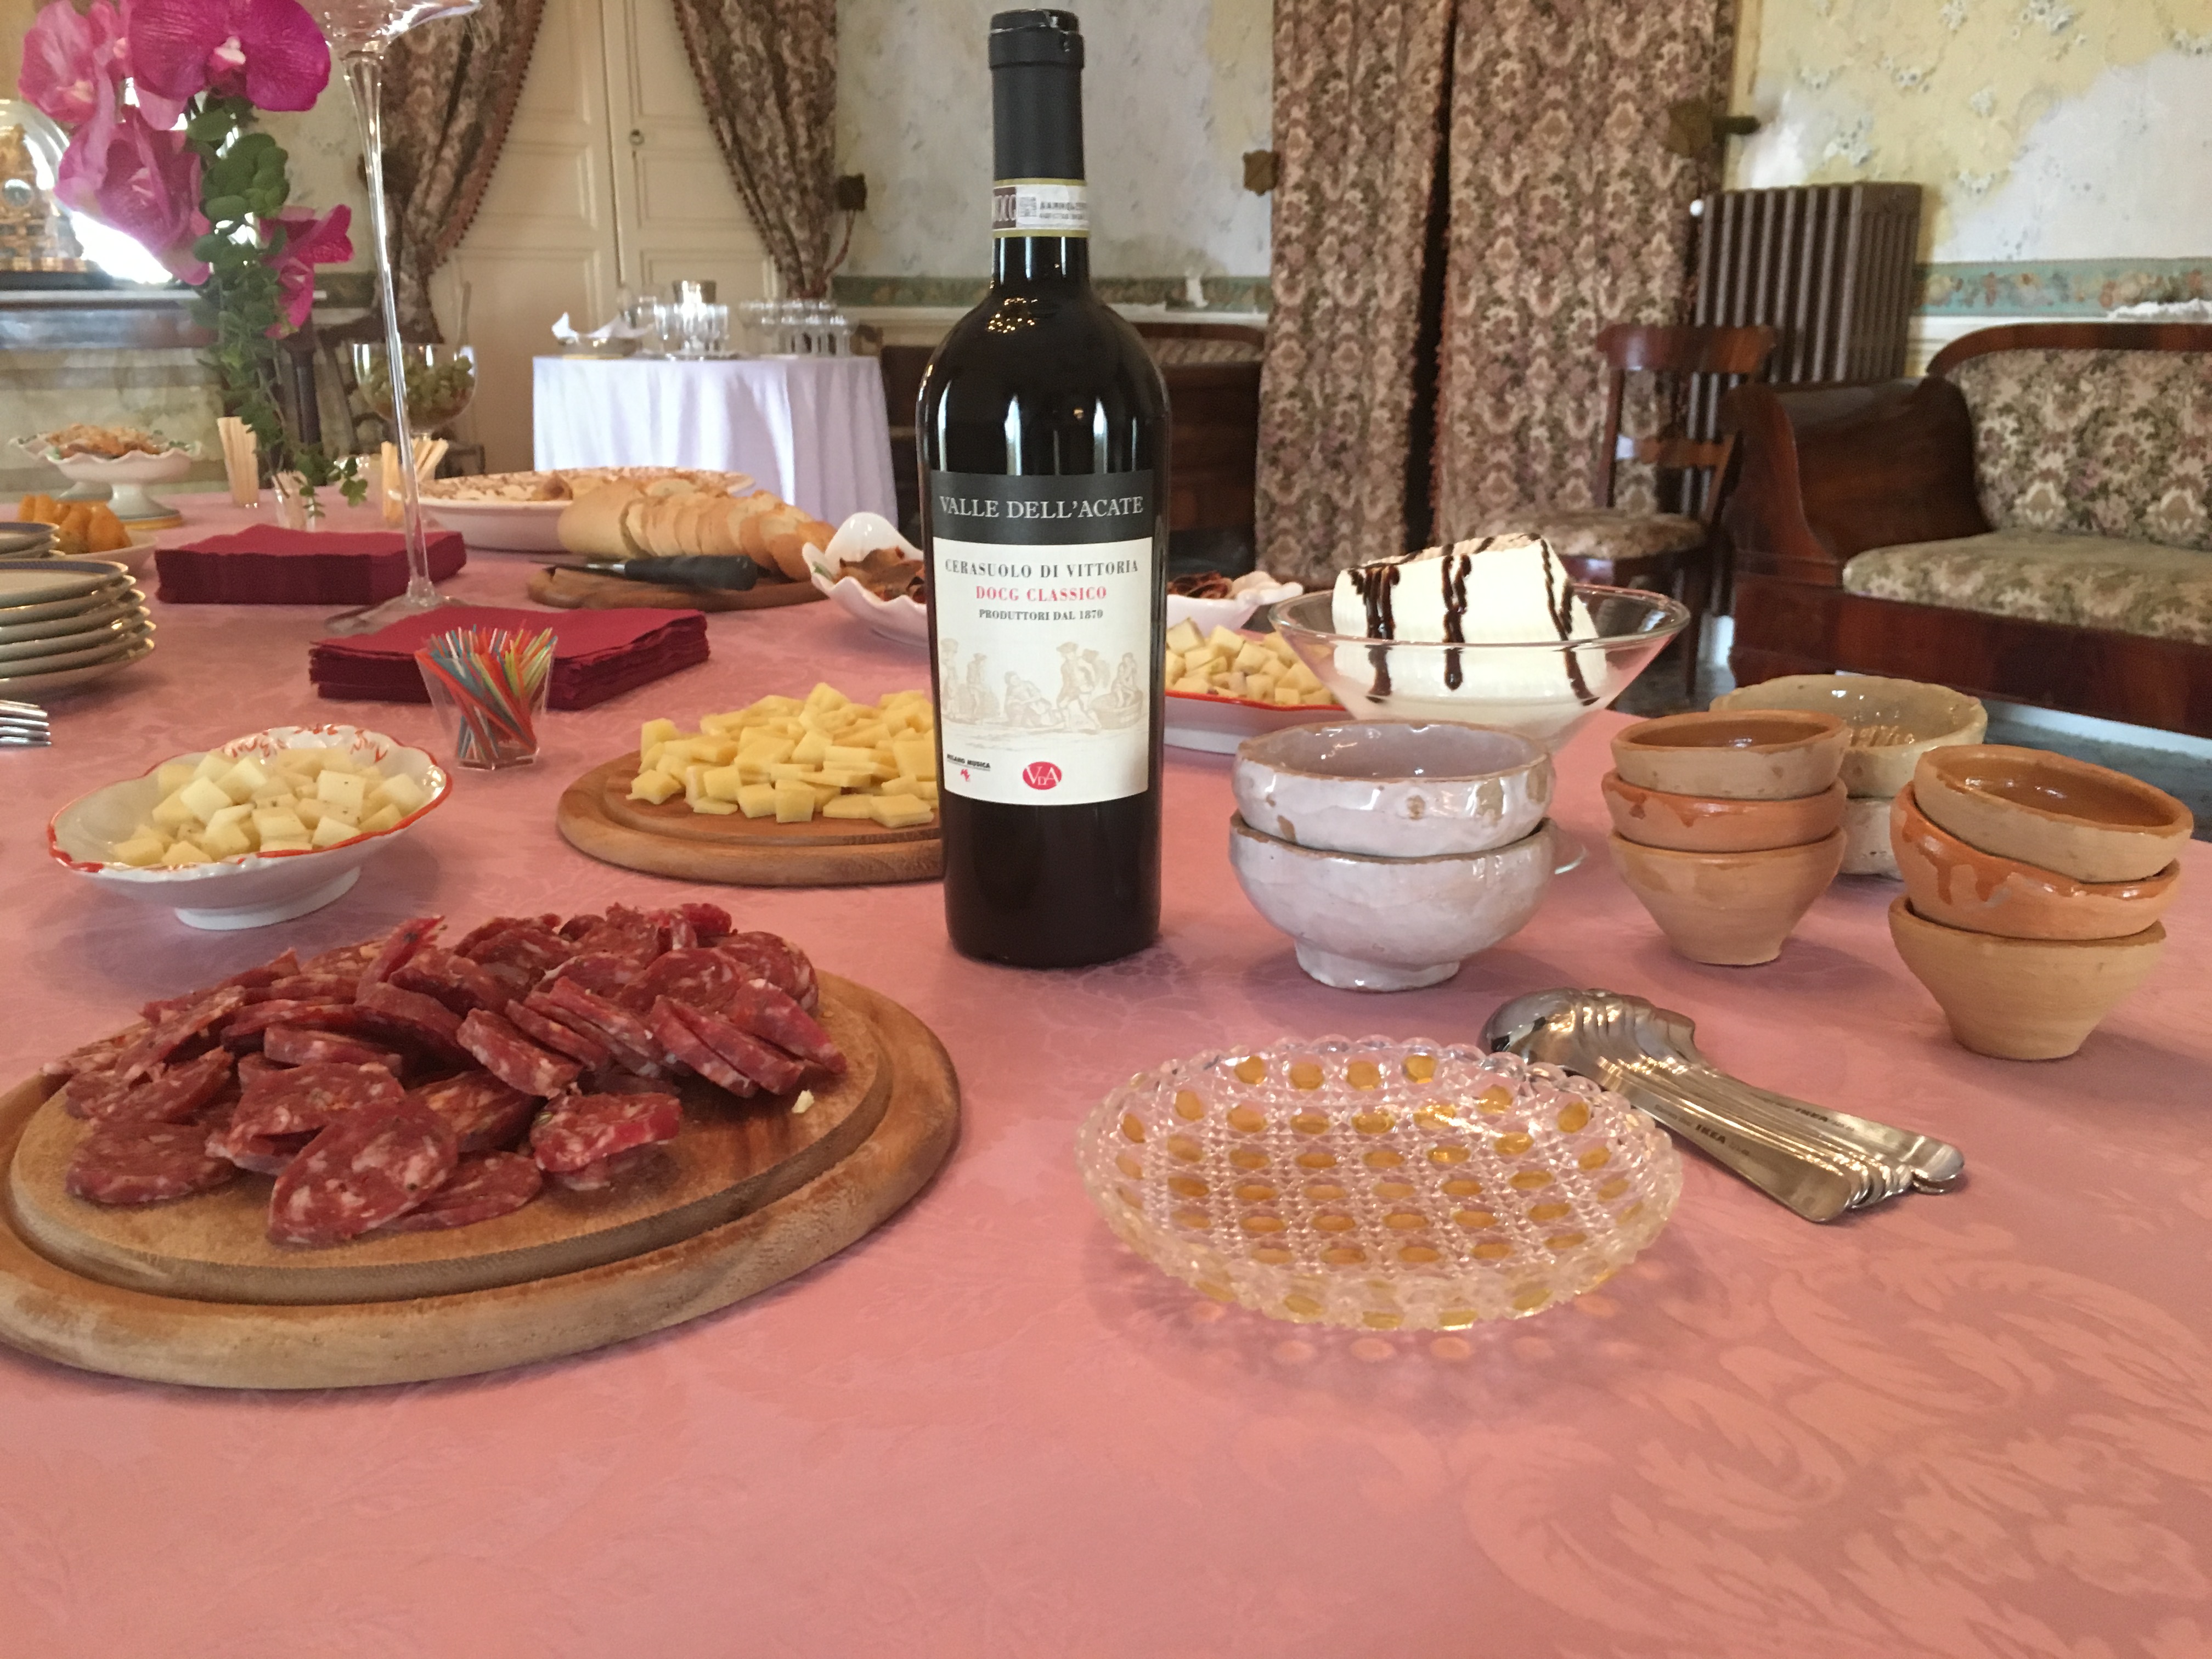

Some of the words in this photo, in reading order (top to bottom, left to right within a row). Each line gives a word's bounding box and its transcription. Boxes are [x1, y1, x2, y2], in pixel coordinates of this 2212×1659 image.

[939, 495, 1000, 518] VALLE
[1006, 495, 1144, 519] DELL'ACATE
[945, 558, 1032, 578] CERASUOLO
[1041, 565, 1059, 578] DI
[1066, 559, 1138, 577] VITTORIA
[976, 585, 1019, 601] DOCG
[1026, 586, 1107, 602] CLASSICO
[979, 609, 1050, 620] PRODUTTORI
[1053, 611, 1076, 620] DAL
[1695, 1124, 1726, 1144] IKEA
